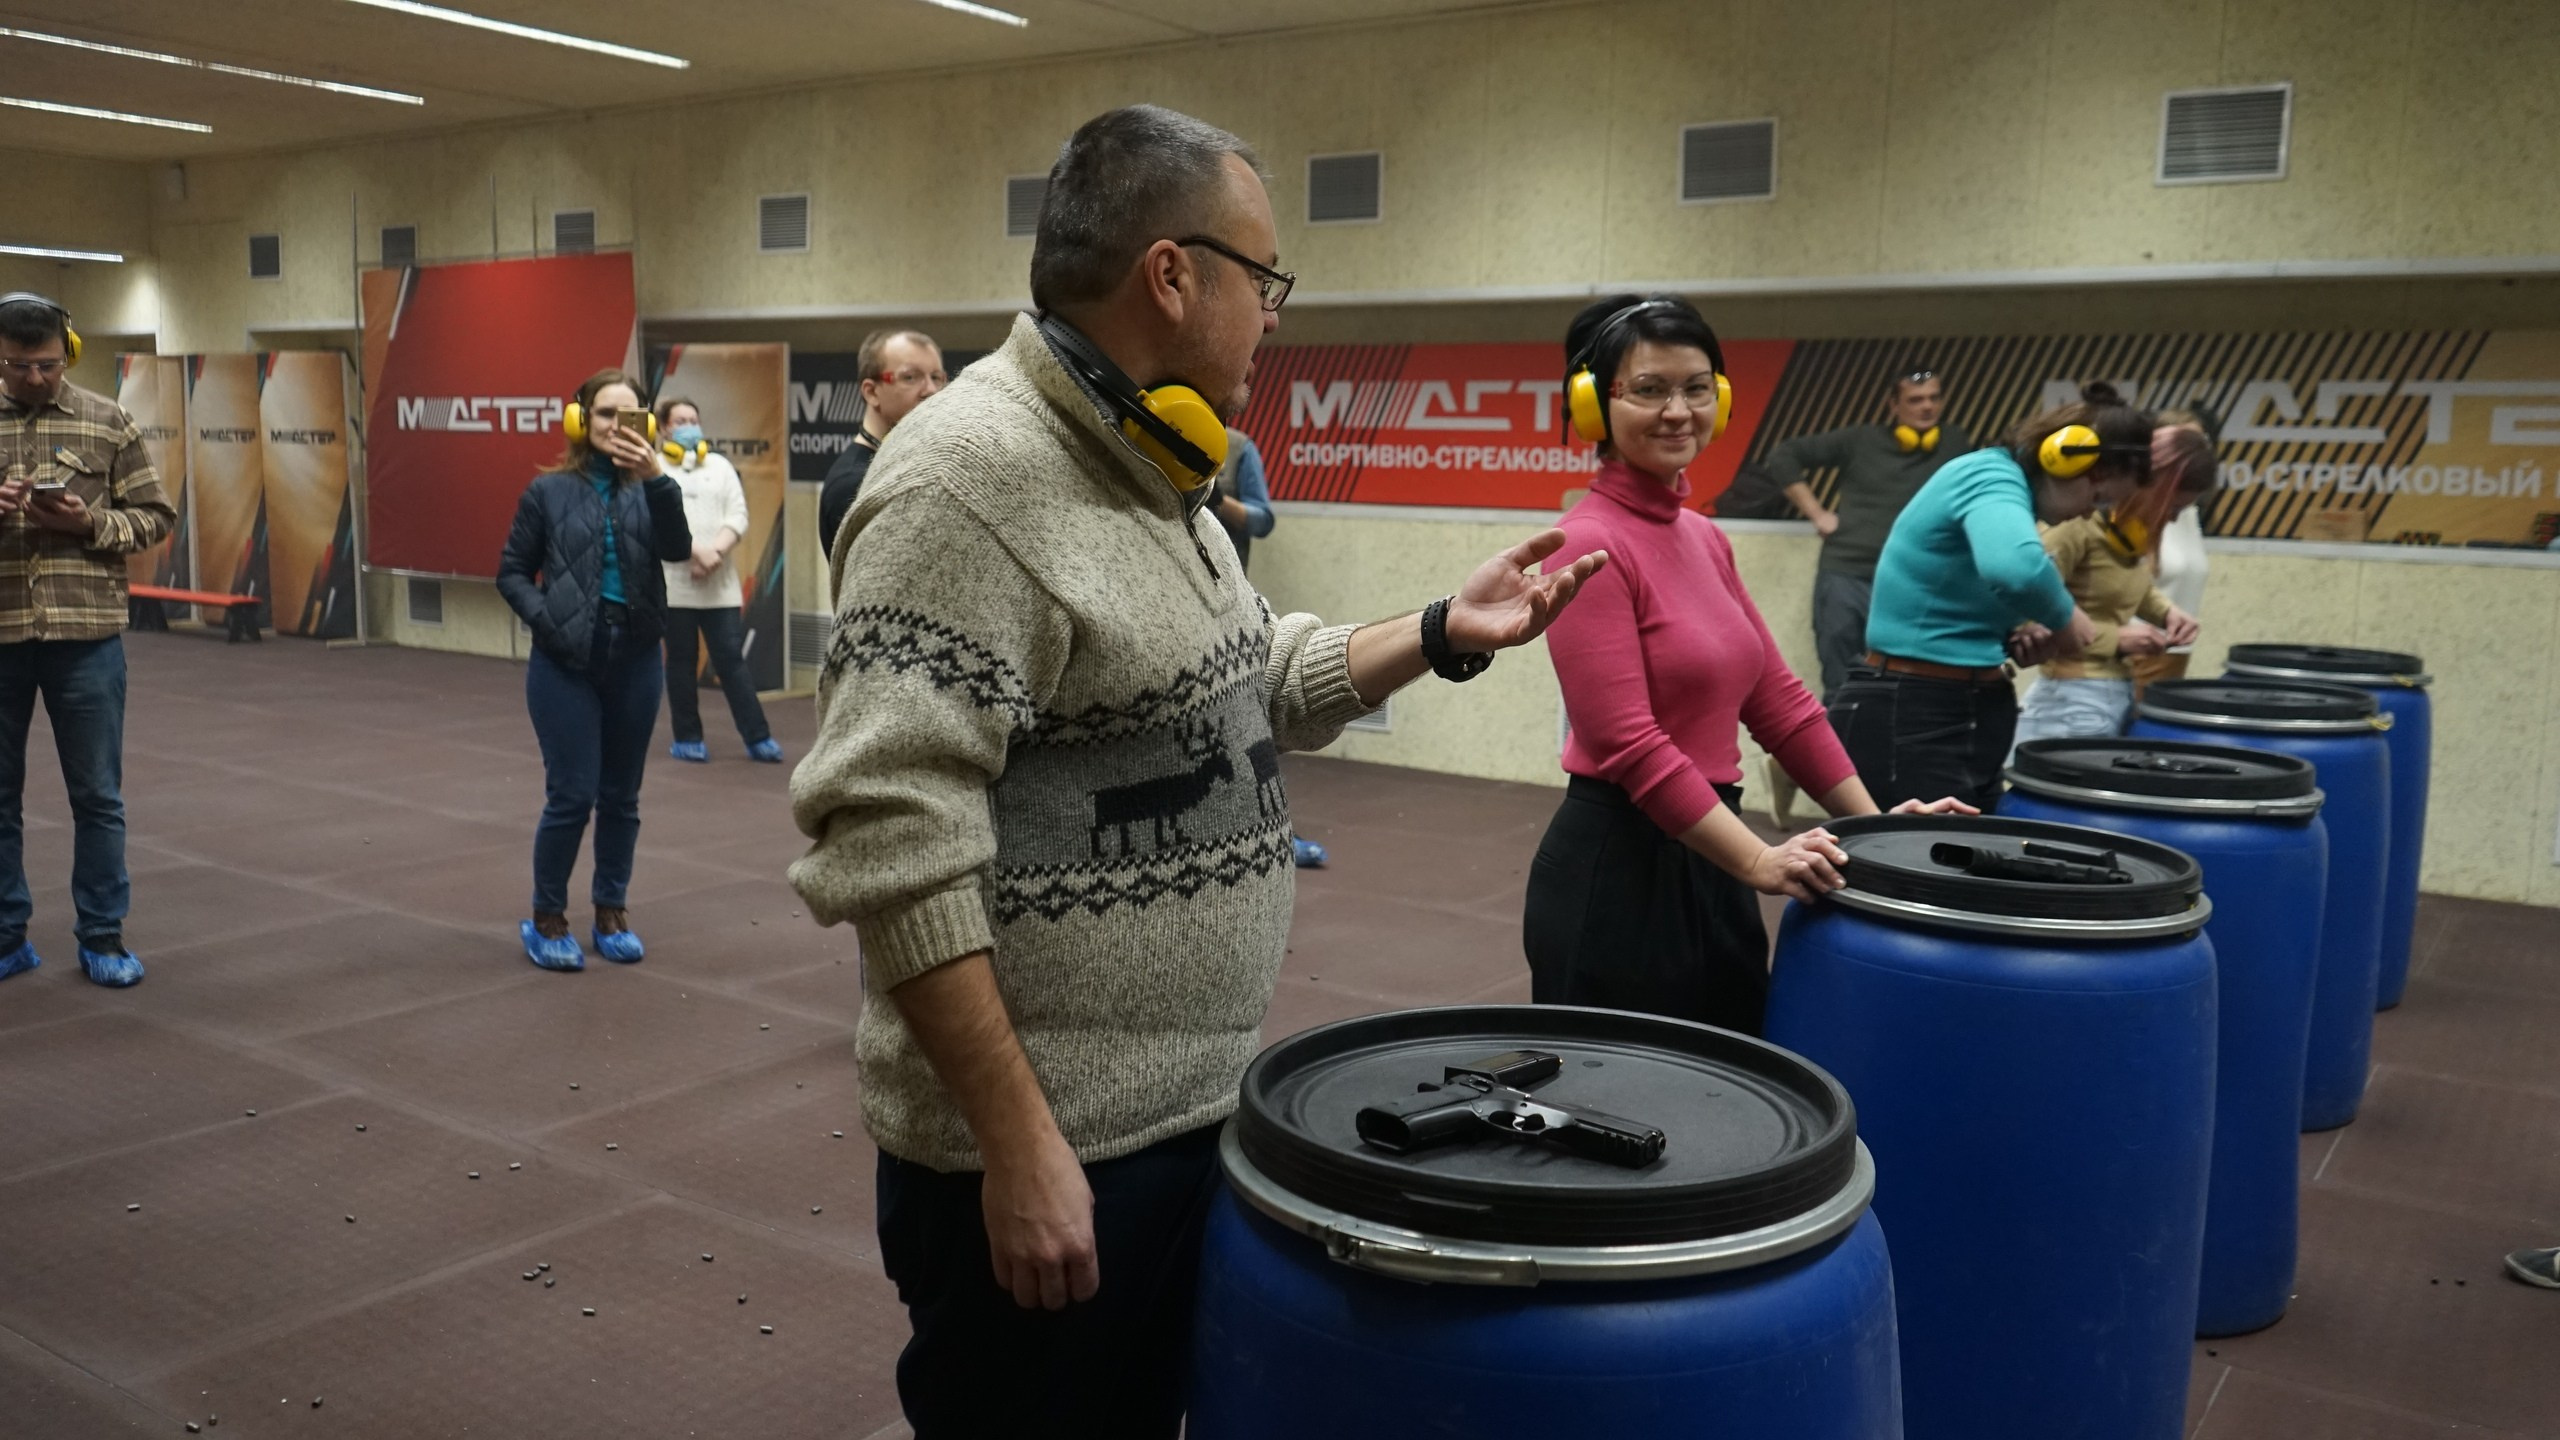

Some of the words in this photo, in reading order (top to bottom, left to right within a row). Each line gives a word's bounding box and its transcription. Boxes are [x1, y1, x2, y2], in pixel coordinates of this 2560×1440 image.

[397, 396, 562, 432] МАСТЕР
[1290, 379, 1567, 432] МАСТ
[140, 425, 178, 441] АСТЕР
[200, 428, 256, 443] МАСТЕР
[270, 429, 336, 445] МАСТЕР
[706, 438, 770, 456] АСТЕР
[2214, 459, 2542, 498] О-СТРЕЛКОВЫЙ
